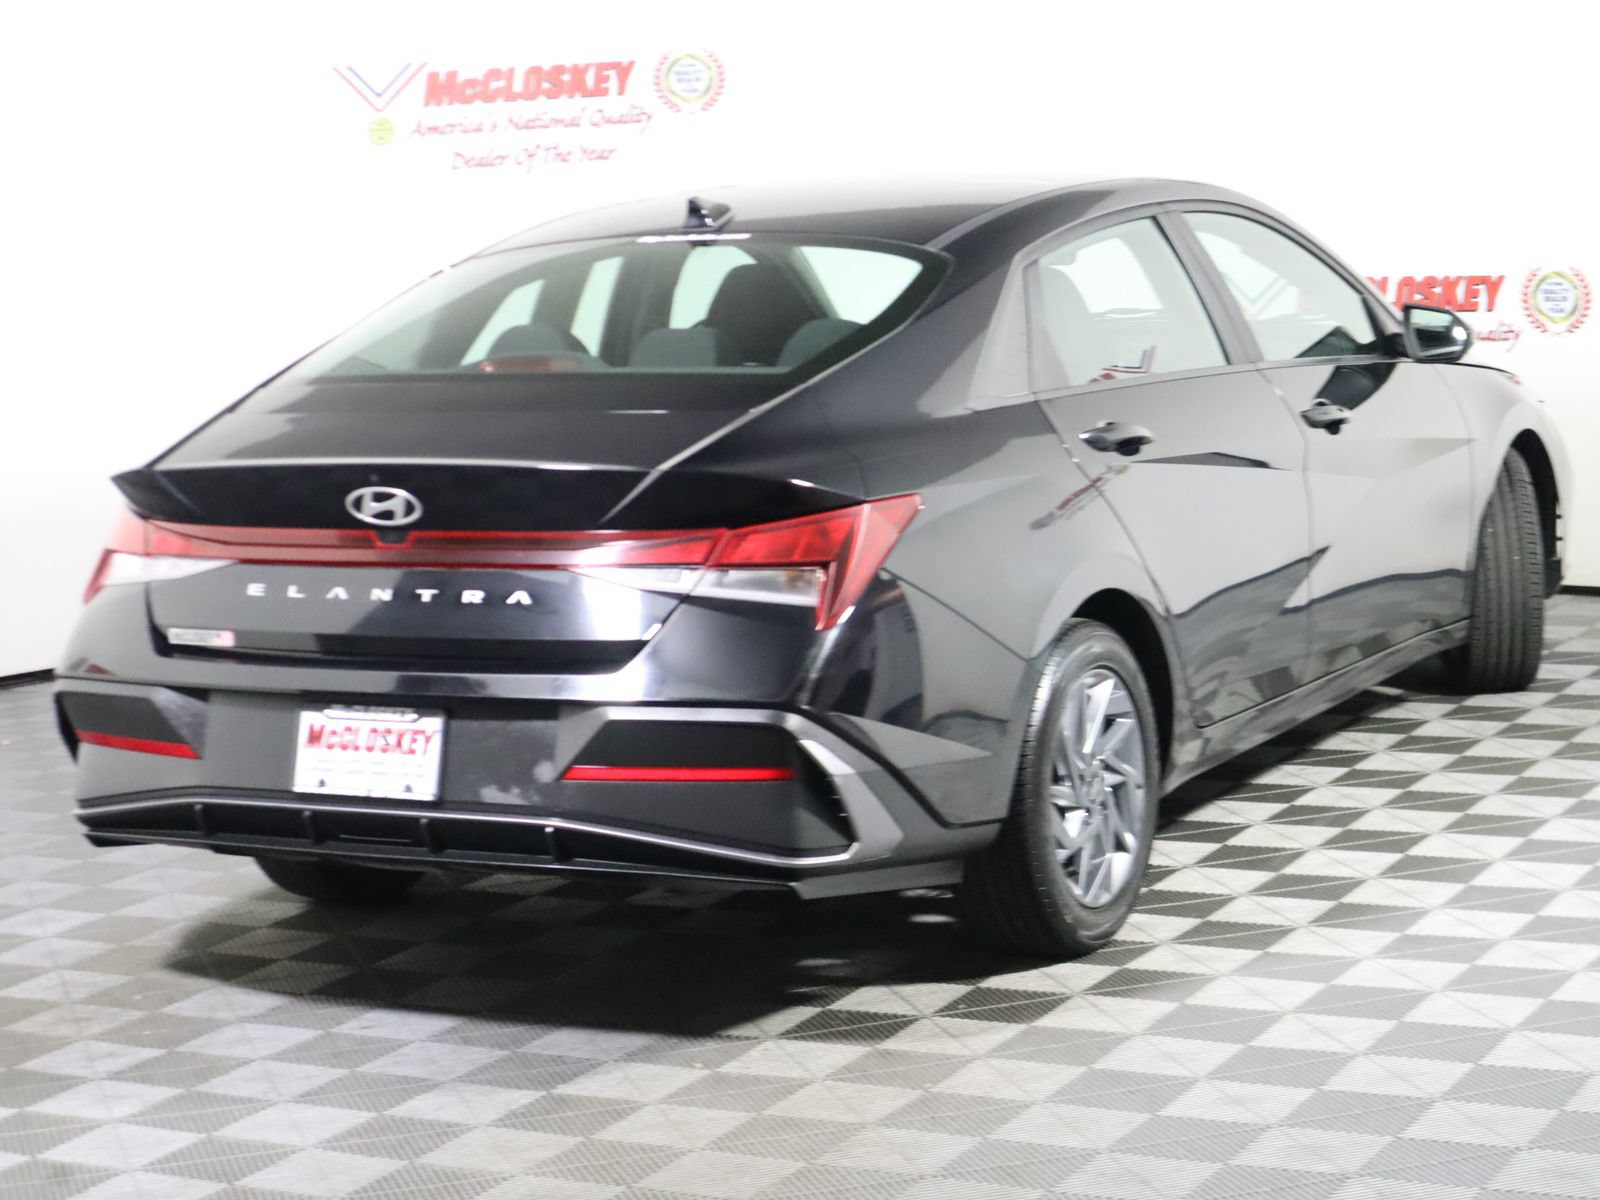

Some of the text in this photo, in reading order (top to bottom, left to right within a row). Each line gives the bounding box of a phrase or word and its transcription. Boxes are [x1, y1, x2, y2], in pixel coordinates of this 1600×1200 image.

[423, 60, 635, 106] McCLOSKEY
[409, 113, 498, 138] America's
[508, 106, 587, 131] National
[590, 103, 653, 134] Quality
[451, 143, 617, 175] Dealer Of The Year
[245, 583, 534, 605] ELANTRA
[304, 723, 436, 756] McCLOSKEY
